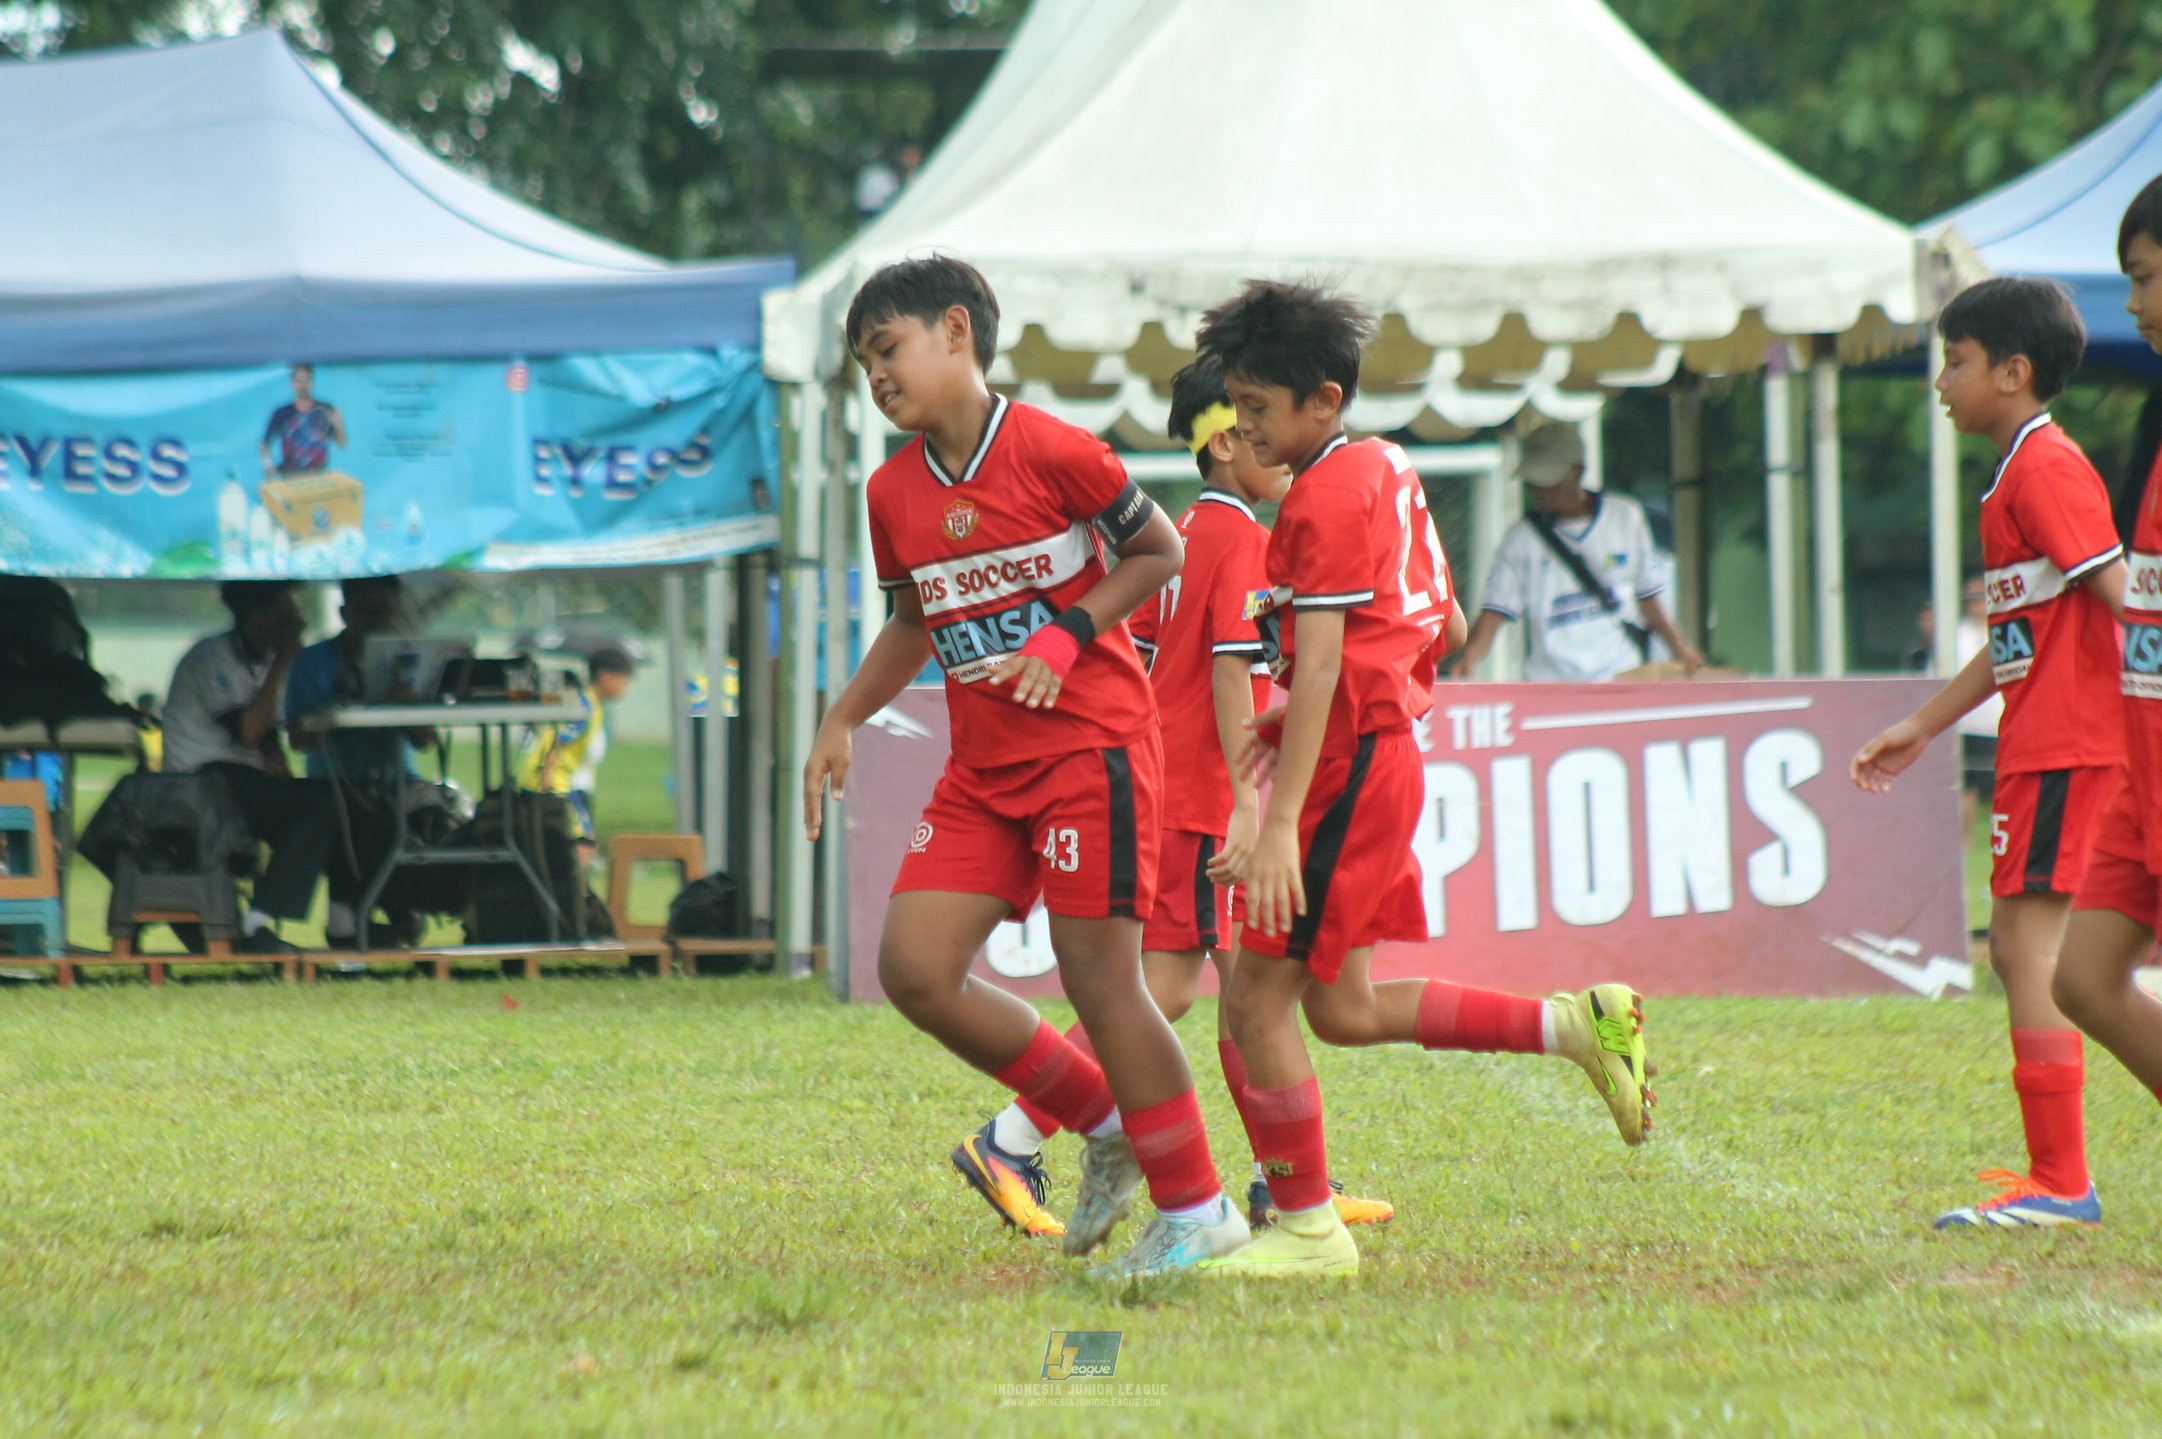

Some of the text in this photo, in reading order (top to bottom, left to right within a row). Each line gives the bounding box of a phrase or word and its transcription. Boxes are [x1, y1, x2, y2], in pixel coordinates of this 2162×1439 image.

[956, 554, 1054, 596] SOCCER
[930, 600, 1054, 667] HENSA
[1446, 701, 1515, 751] THE
[1043, 828, 1079, 872] 43
